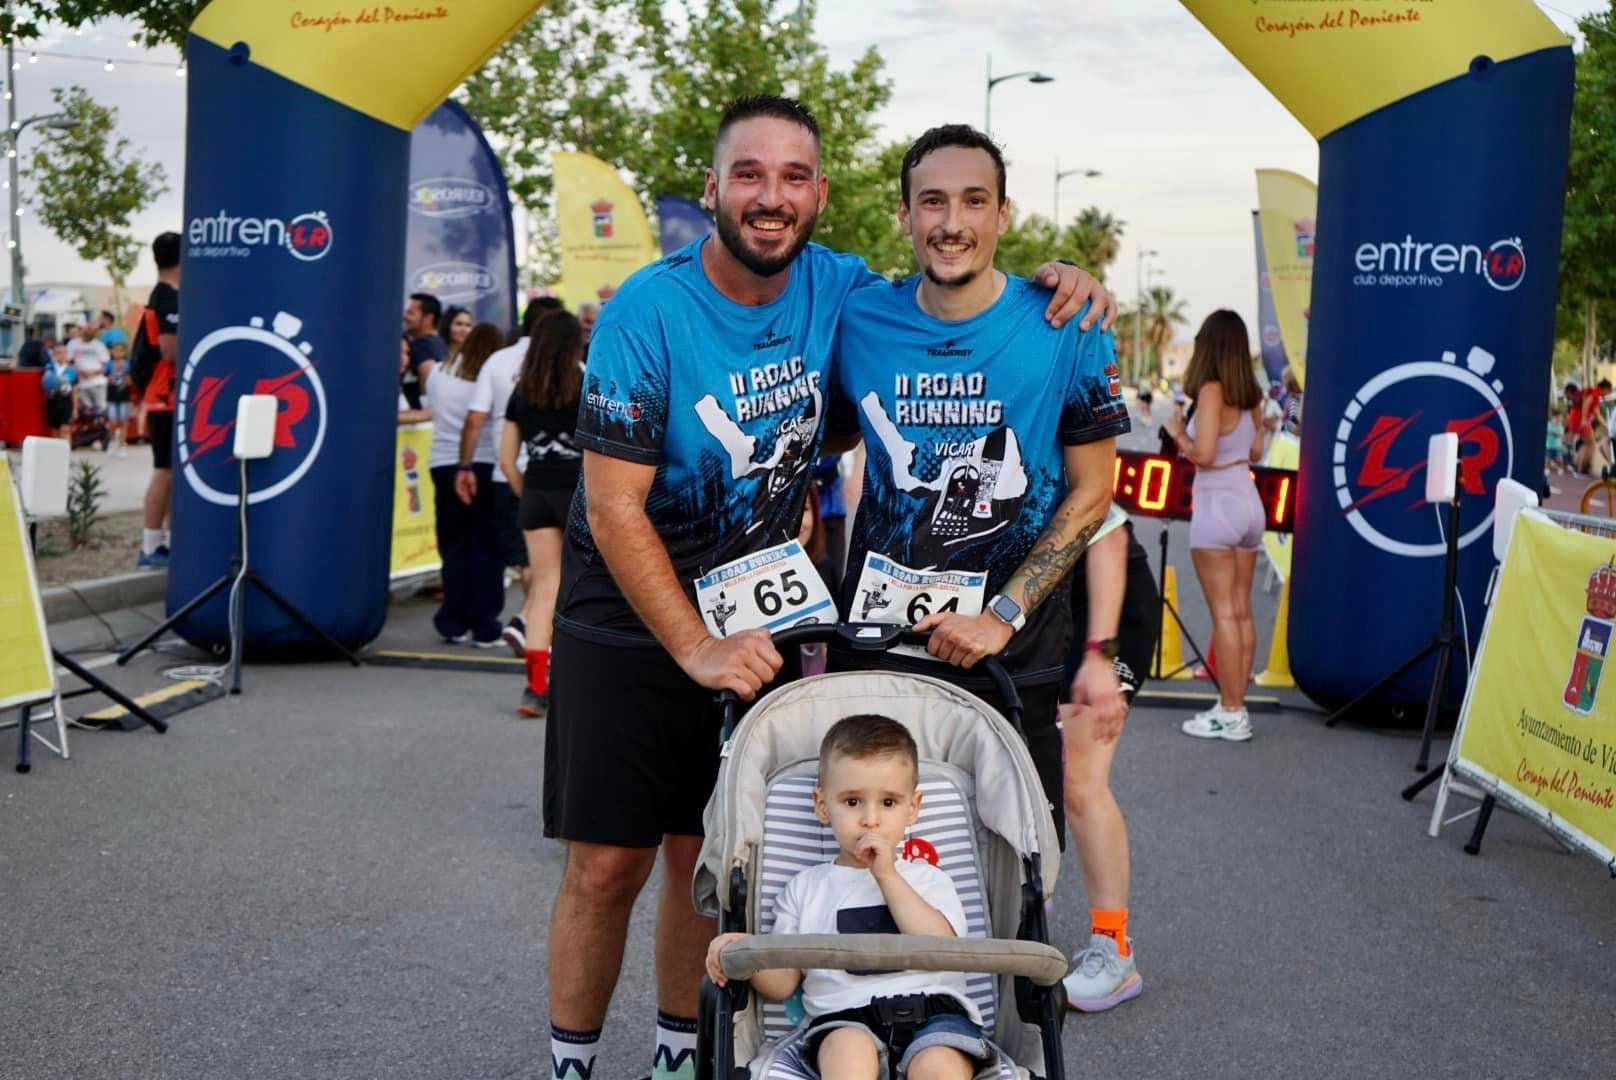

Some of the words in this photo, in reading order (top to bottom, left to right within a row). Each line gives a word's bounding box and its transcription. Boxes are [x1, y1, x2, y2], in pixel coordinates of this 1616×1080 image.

[291, 11, 352, 32] Corazón
[355, 8, 379, 24] del
[383, 6, 449, 24] Poniente
[1256, 15, 1315, 38] Corazón
[1319, 10, 1345, 30] del
[1349, 8, 1421, 29] Poniente
[1353, 274, 1376, 286] club
[1379, 274, 1443, 288] deportivo
[730, 371, 746, 396] II
[750, 356, 803, 393] ROAD
[895, 372, 911, 399] II
[917, 372, 986, 399] ROAD
[736, 370, 822, 423] RUNNING
[896, 400, 1004, 427] RUNNING
[935, 438, 975, 457] VÍCAR
[720, 560, 749, 582] ROAD
[749, 547, 790, 571] RUNNING
[893, 567, 920, 585] ROAD
[921, 573, 969, 586] RUNNING
[753, 568, 808, 617] 65
[1517, 706, 1582, 757] Ayuntamiento
[1583, 738, 1597, 764] de
[1550, 767, 1570, 793] del
[1566, 768, 1615, 809] Poniente
